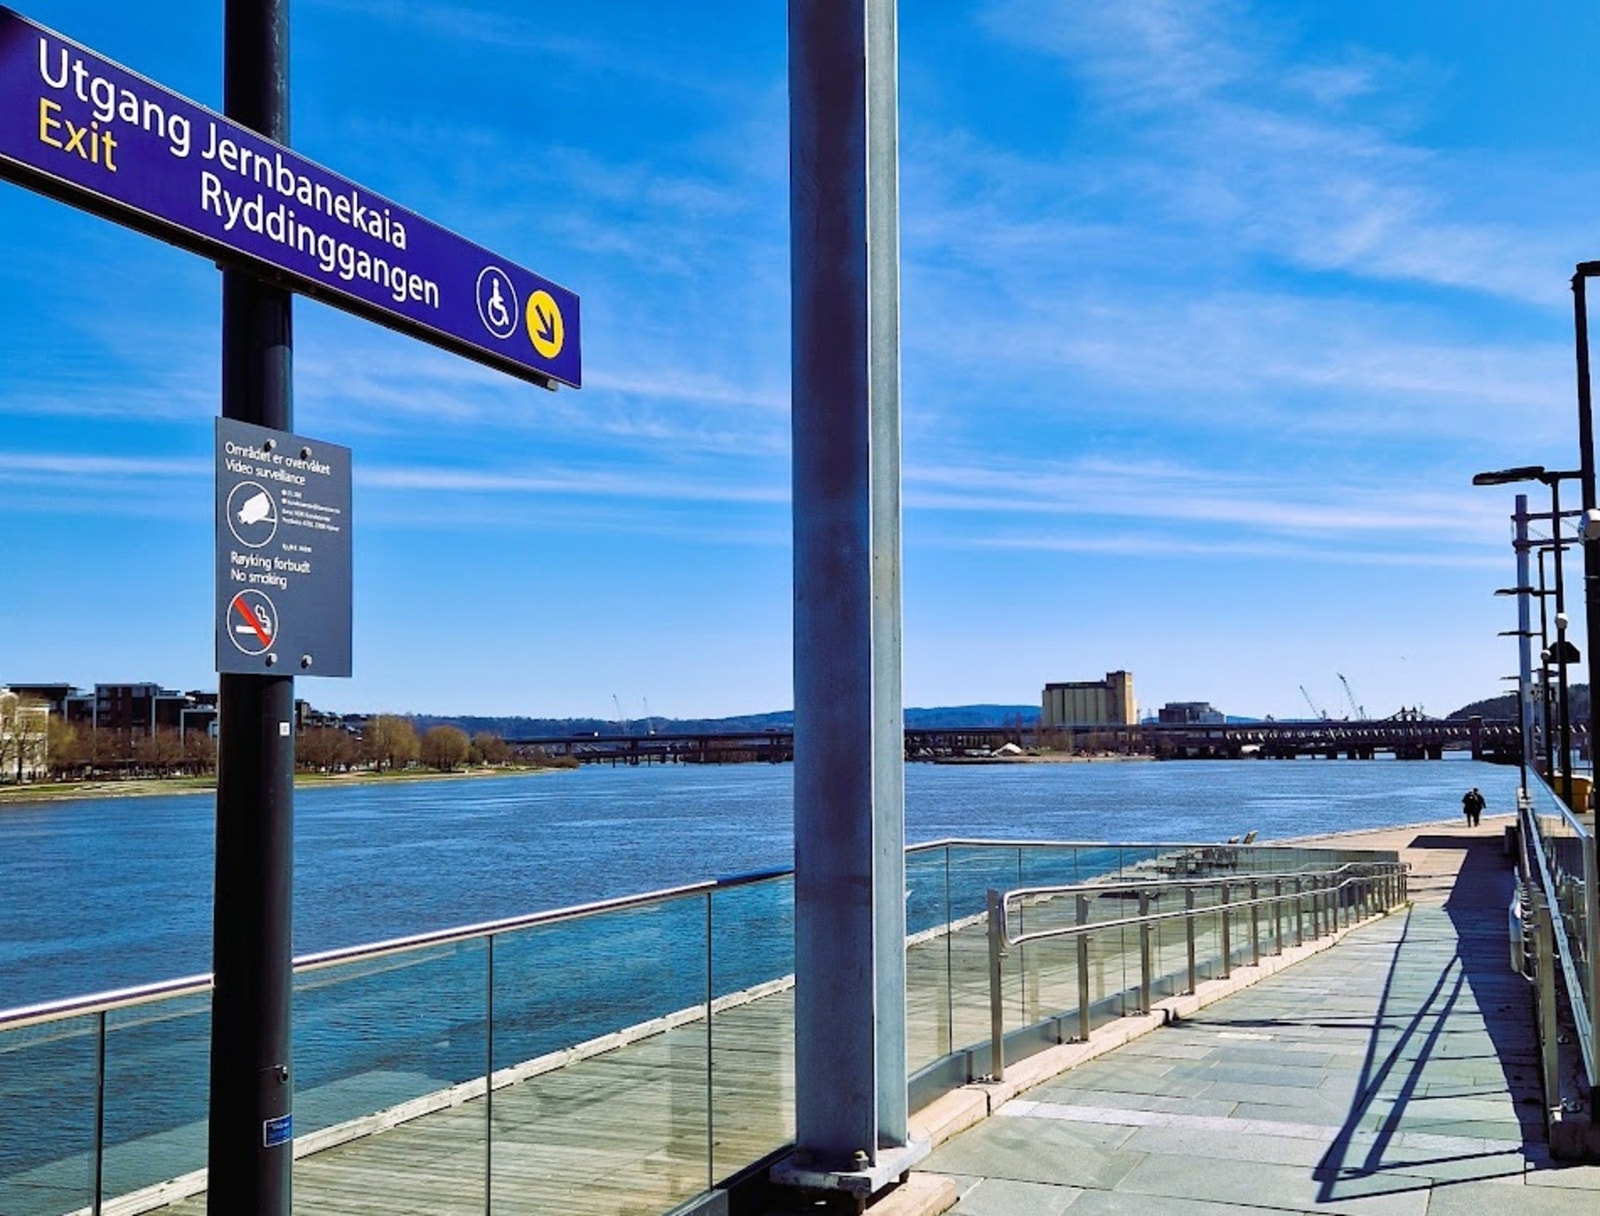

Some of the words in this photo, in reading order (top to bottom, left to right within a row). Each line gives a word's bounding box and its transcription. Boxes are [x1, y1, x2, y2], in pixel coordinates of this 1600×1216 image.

[39, 98, 118, 172] Exit
[39, 39, 190, 157] Utgang
[201, 122, 406, 250] Jernbanekaia
[201, 171, 440, 309] Ryddinggangen
[225, 441, 271, 462] Området
[273, 454, 283, 464] er
[285, 457, 331, 475] overvåket
[225, 458, 253, 475] Video
[255, 467, 306, 485] surveillance
[230, 551, 272, 571] Røyking
[274, 557, 311, 573] forbudt
[230, 569, 247, 581] No
[248, 573, 287, 590] smoking
